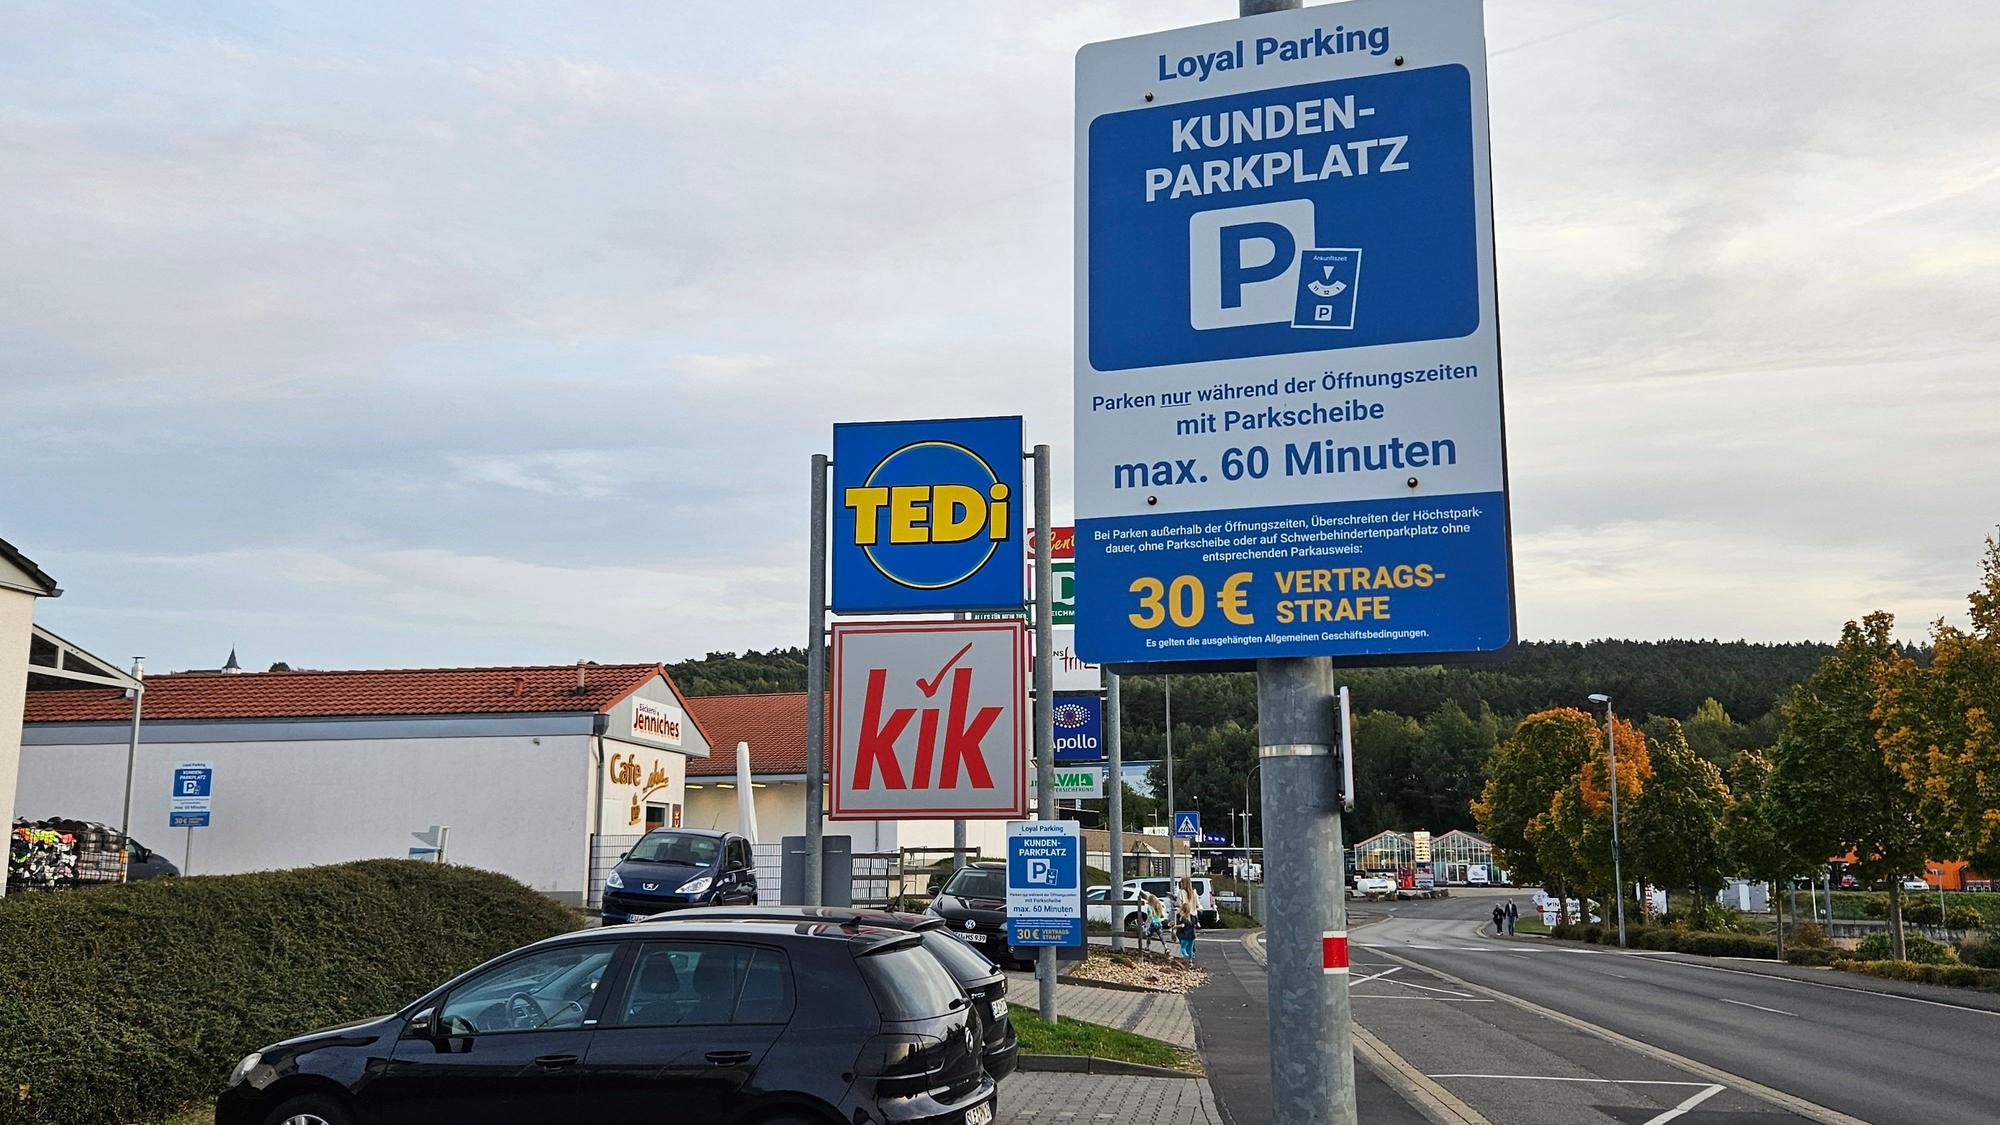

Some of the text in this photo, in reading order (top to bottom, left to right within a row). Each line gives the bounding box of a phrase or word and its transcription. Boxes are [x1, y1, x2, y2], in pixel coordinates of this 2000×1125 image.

[1158, 25, 1390, 82] Loyal Parking
[1172, 95, 1375, 152] KUNDEN-
[1145, 136, 1409, 202] PARKPLATZ
[1219, 221, 1296, 309] P
[1319, 307, 1330, 318] P
[1092, 364, 1478, 411] Parken nur während der Öffnungszeiten
[1176, 399, 1385, 435] mit Parkscheibe
[1114, 437, 1456, 488] max. 60 Minuten
[844, 482, 1011, 547] TEDi
[1094, 506, 1484, 541] Bei Parken außerhalb der Öffnungszeiten, Überschreiten der Höchstpark-
[1105, 522, 1471, 554] dauer, ohne Parkscheibe oder auf Schwerbehindertenparkplatz ohne
[1202, 543, 1363, 563] entsprechenden Parkausweis:
[1274, 563, 1446, 594] VERTRAGS-
[1128, 571, 1255, 629] 30 €
[1276, 596, 1391, 624] STRAFE
[1146, 628, 1430, 648] Es gelten die ausgehängten Allgemeinen Geschäftsbedingungen.
[633, 708, 679, 737] Jenniches
[186, 782, 195, 791] P
[1021, 825, 1064, 833] Loyal Parking
[1024, 839, 1061, 847] KUNDEN-
[1032, 862, 1047, 879] P
[1044, 905, 1073, 913] Minuten
[1017, 929, 1039, 940] 30 €
